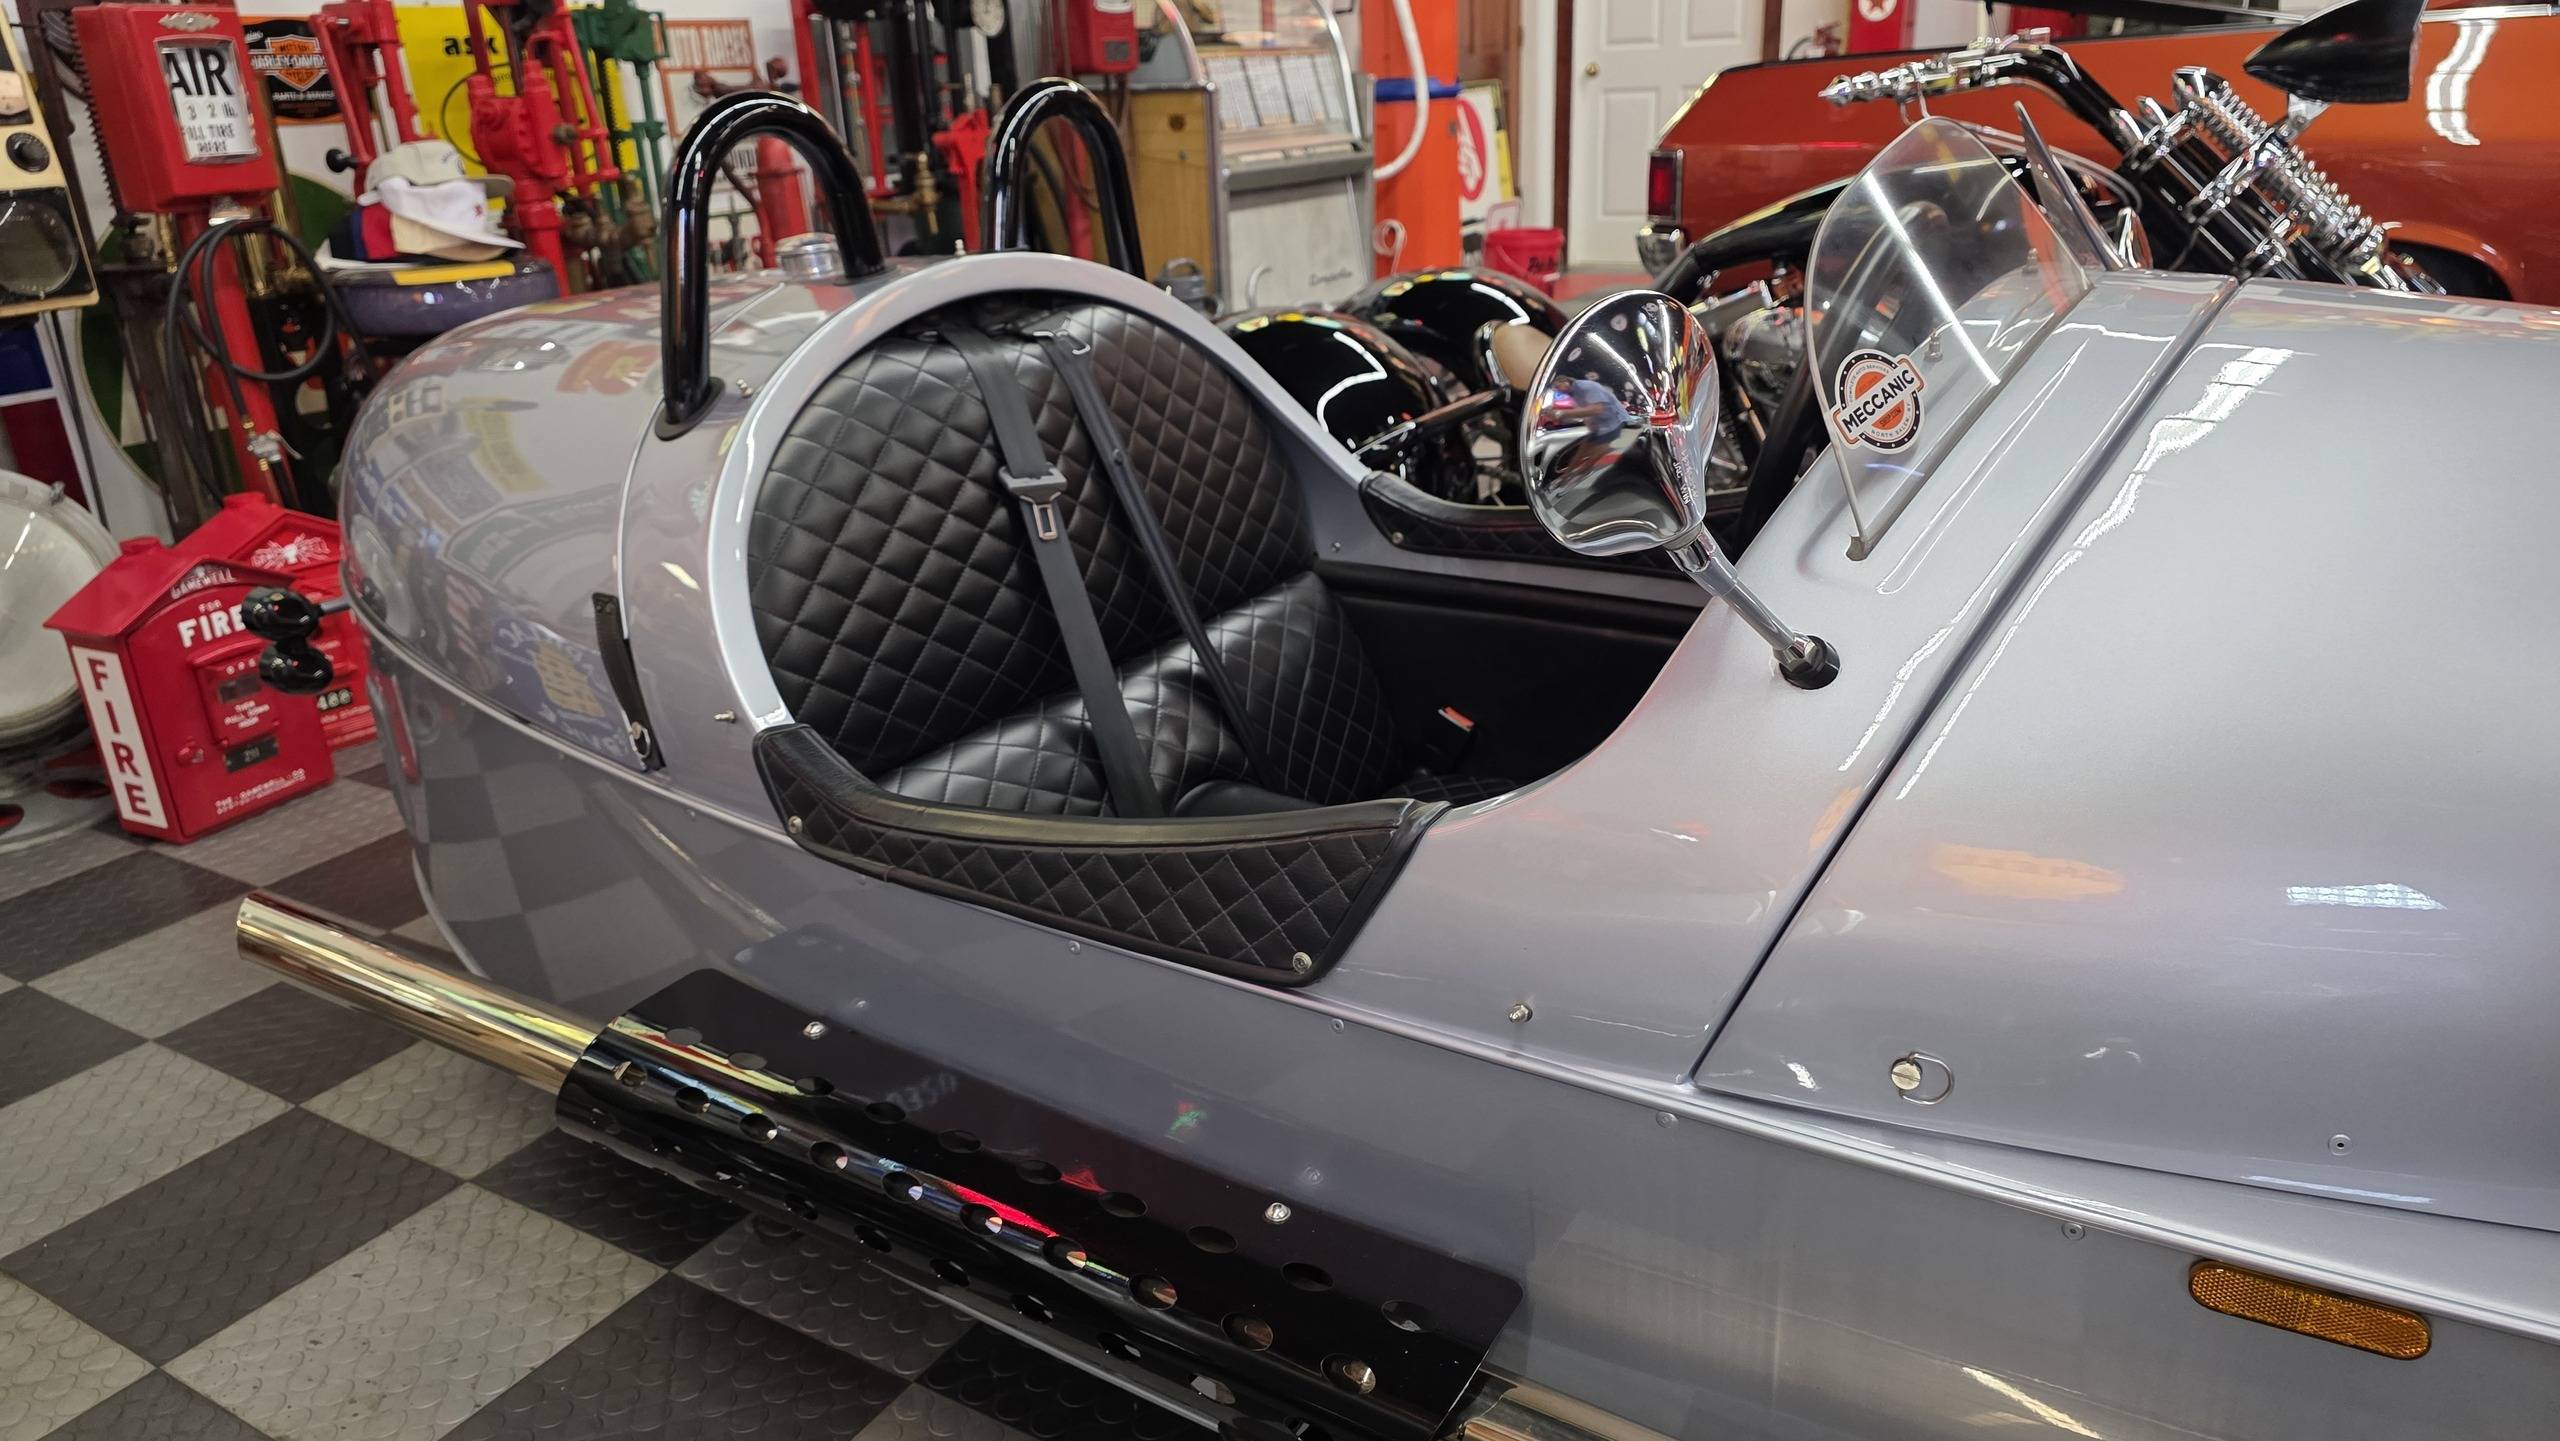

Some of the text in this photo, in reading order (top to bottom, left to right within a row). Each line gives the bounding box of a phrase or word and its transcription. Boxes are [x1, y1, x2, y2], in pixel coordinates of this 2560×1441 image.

[163, 47, 232, 96] AIR
[1842, 369, 1914, 433] MECCANIC
[87, 657, 151, 817] FIRE
